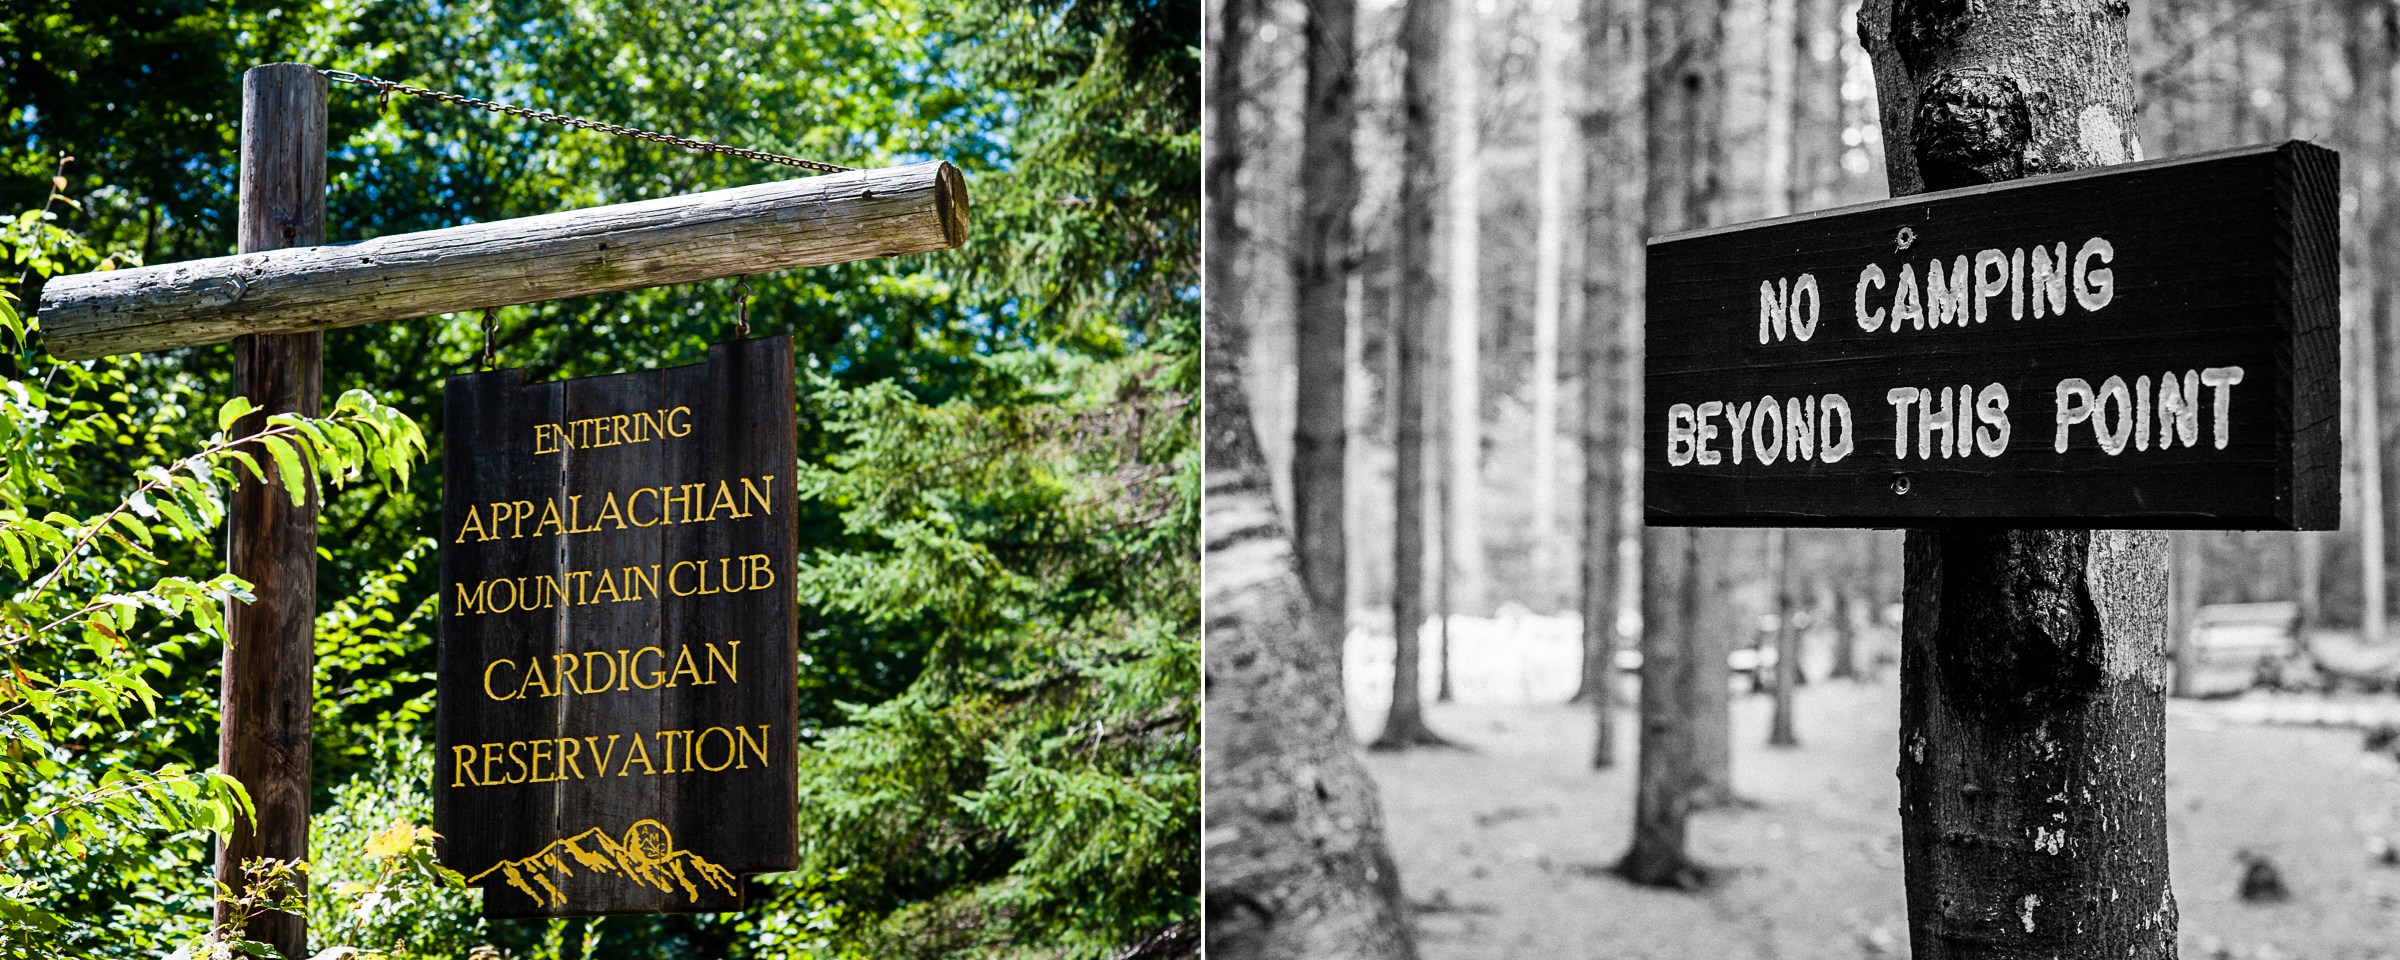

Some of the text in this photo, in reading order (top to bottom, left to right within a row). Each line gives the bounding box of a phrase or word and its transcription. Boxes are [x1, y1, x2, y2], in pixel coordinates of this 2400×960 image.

[1759, 237, 2113, 344] NO CAMPING
[534, 406, 691, 454] ENTERING
[1668, 366, 2244, 467] BEYOND THIS POINT
[456, 475, 774, 543] APPALACHIAN
[456, 554, 774, 616] MOUNTAIN CLUB
[484, 641, 740, 700] CARDIGAN
[452, 725, 770, 787] RESERVATION
